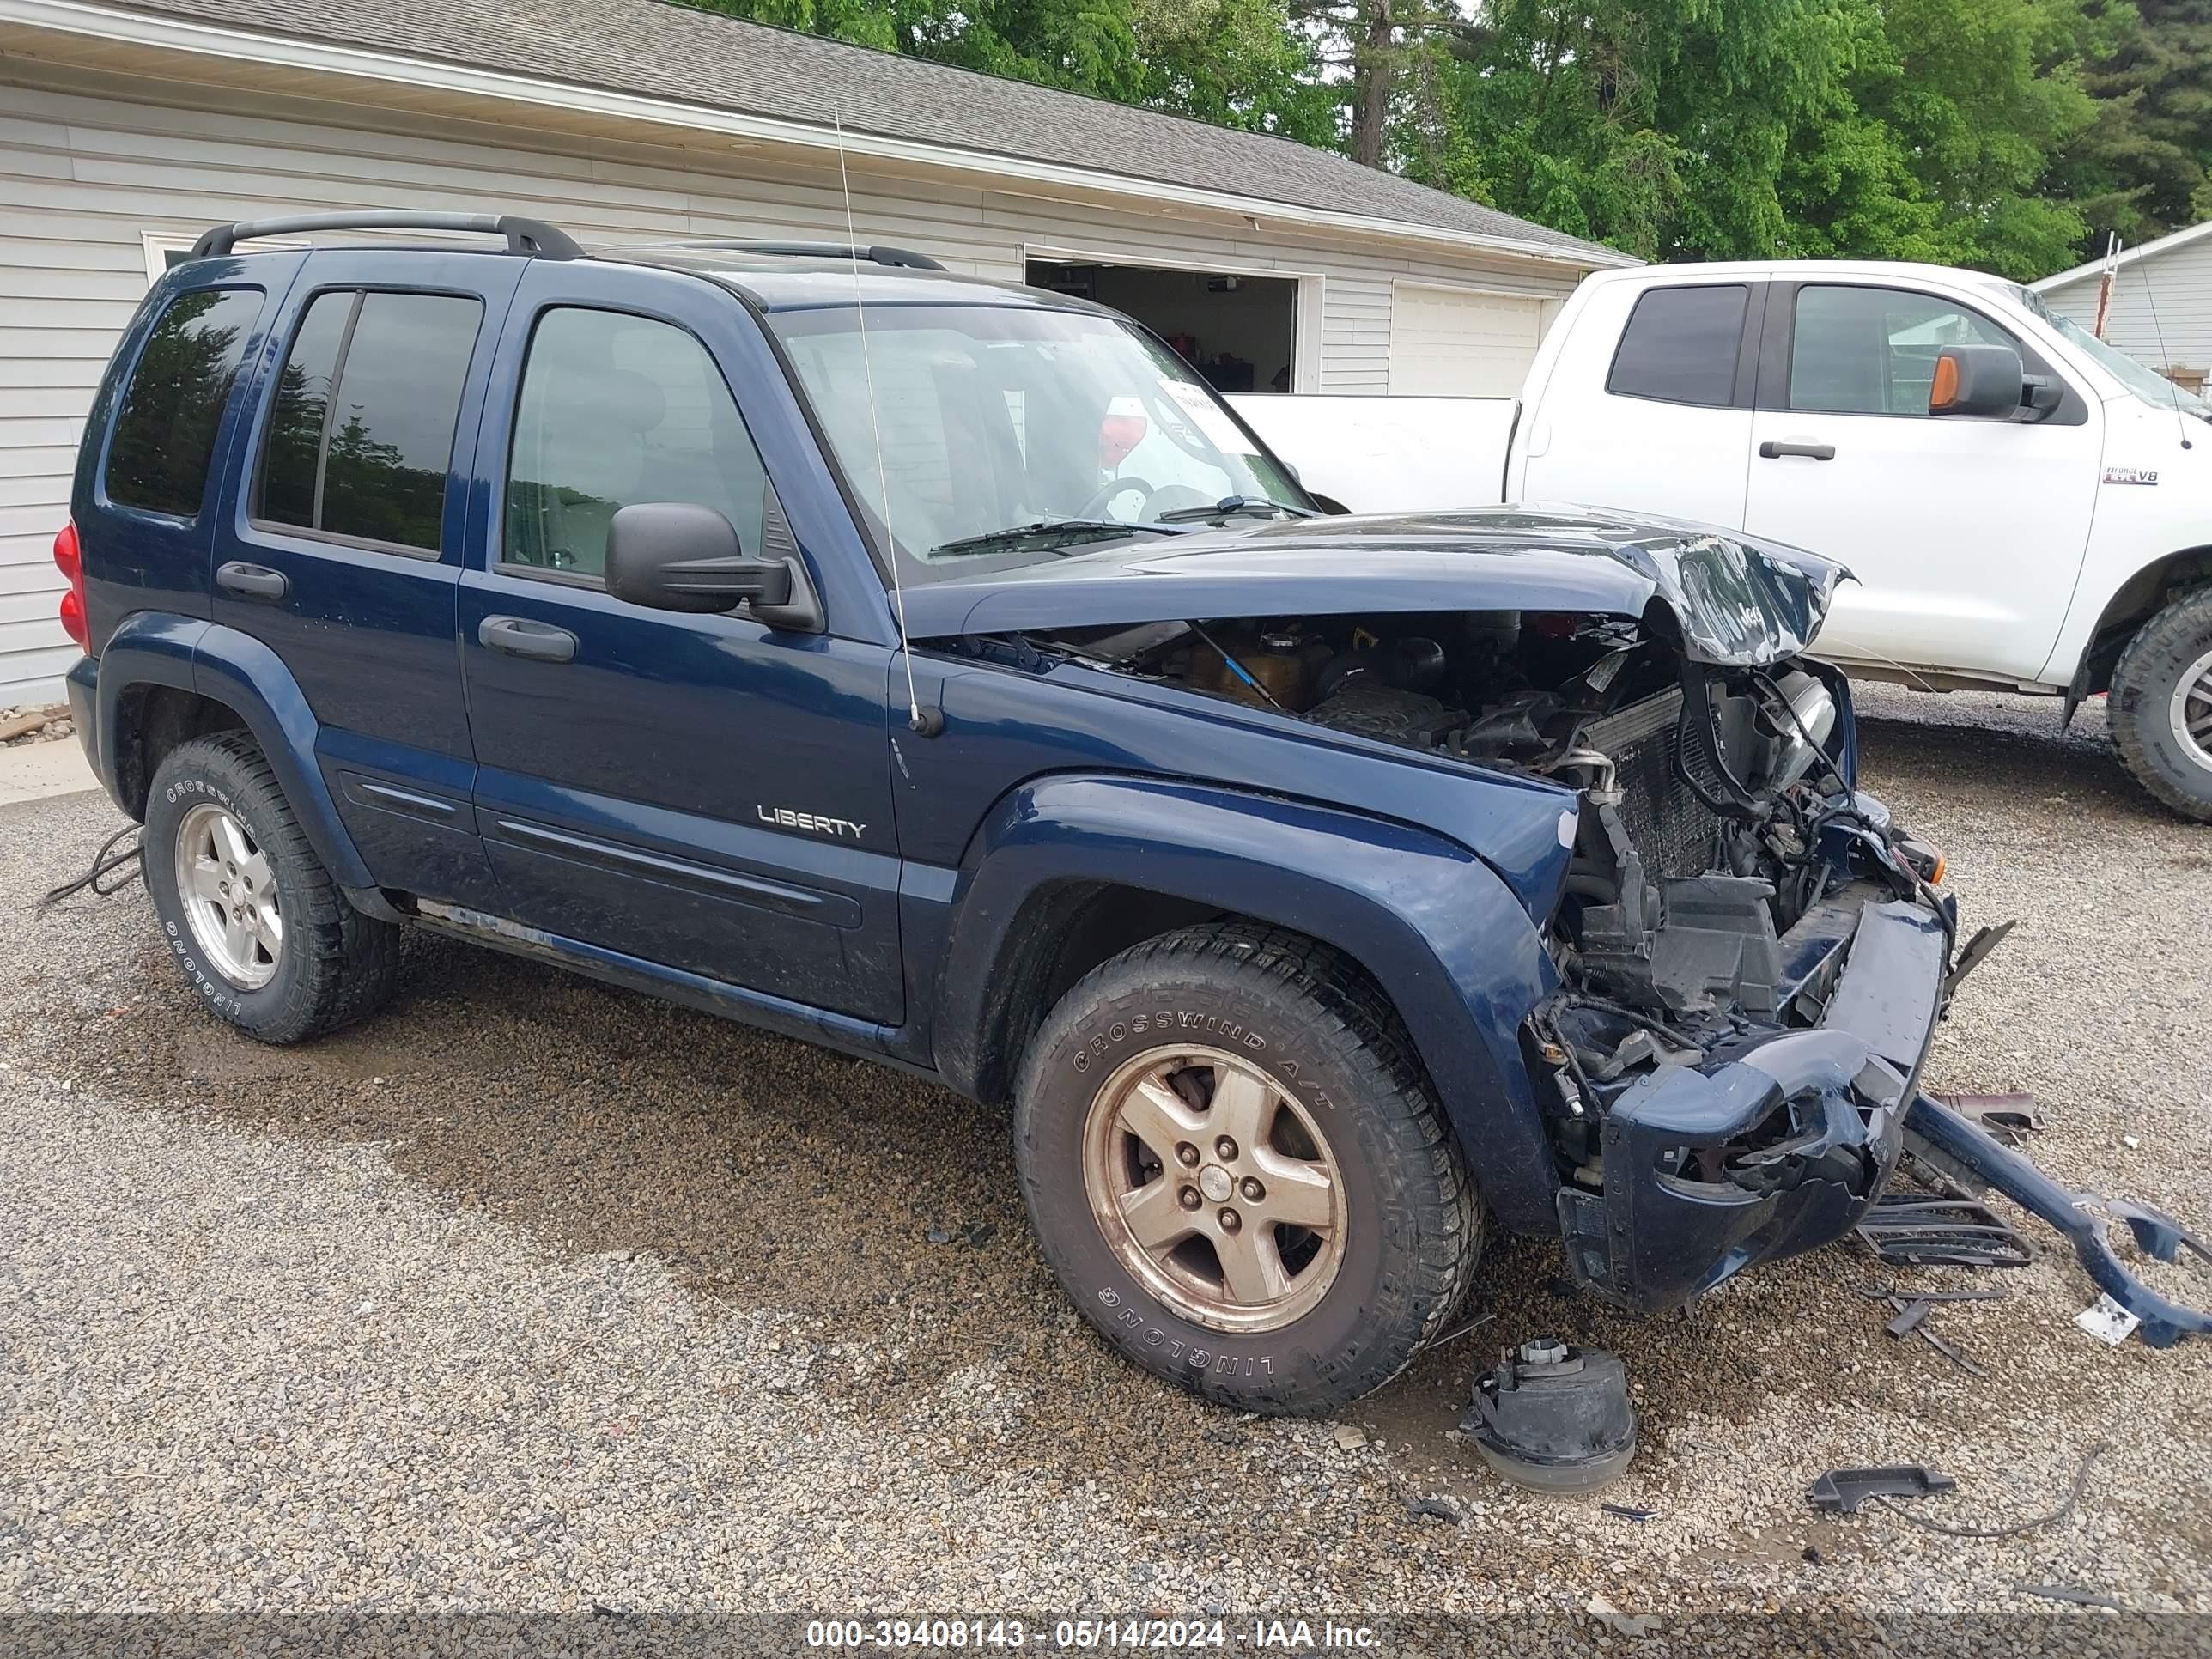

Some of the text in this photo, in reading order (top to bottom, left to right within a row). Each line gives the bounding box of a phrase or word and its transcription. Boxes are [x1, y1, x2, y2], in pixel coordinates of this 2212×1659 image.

[2139, 471, 2158, 482] V8
[166, 780, 257, 838] CROSSWIND
[757, 805, 866, 839] LIBERTY
[166, 921, 242, 1016] LINGLONG
[1073, 1011, 1336, 1111] CROSSWIND A/T
[1098, 1286, 1275, 1376] LINGLONG
